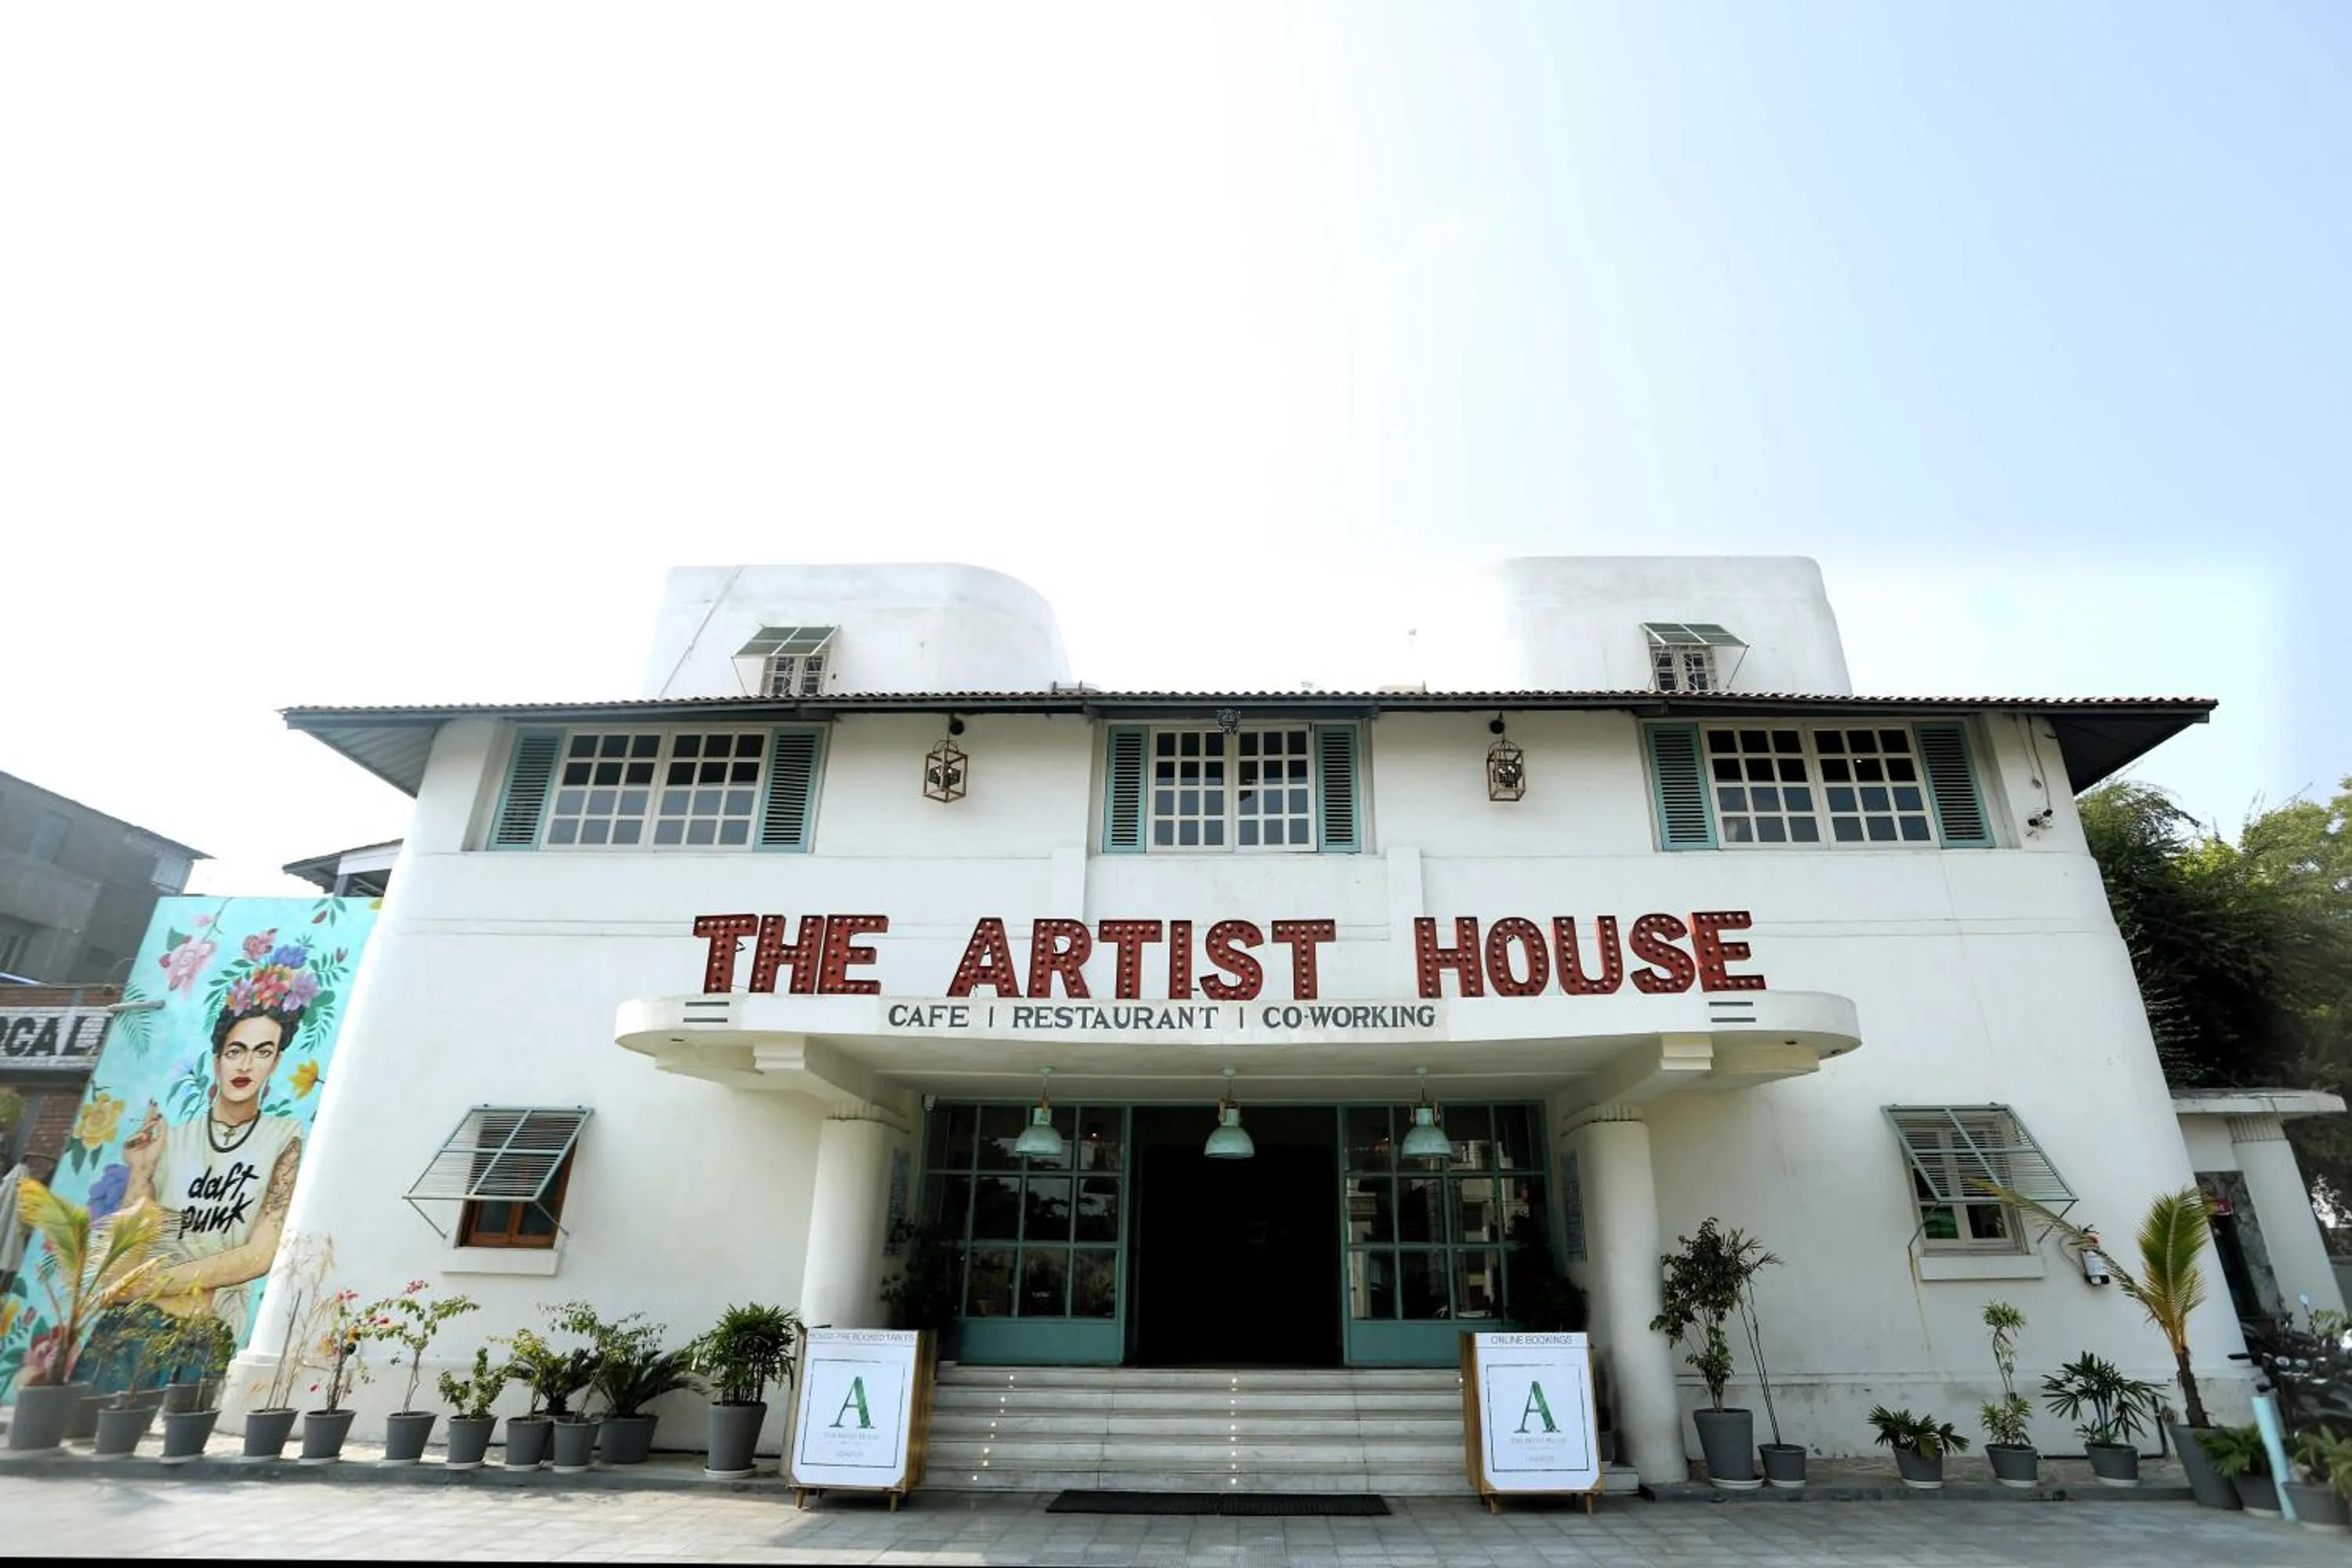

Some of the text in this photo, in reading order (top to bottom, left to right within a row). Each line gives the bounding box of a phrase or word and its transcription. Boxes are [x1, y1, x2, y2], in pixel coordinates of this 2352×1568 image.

[693, 910, 1766, 1001] THE ARTIST HOUSE
[0, 1016, 114, 1056] CAL
[888, 1004, 970, 1028] CAFE
[1012, 1006, 1219, 1029] RESTAURANT
[187, 1161, 260, 1202] daft
[178, 1192, 256, 1240] punk
[1490, 1335, 1573, 1345] ONLINE BOOKINGS
[828, 1376, 877, 1429] A
[1514, 1381, 1561, 1434] A
